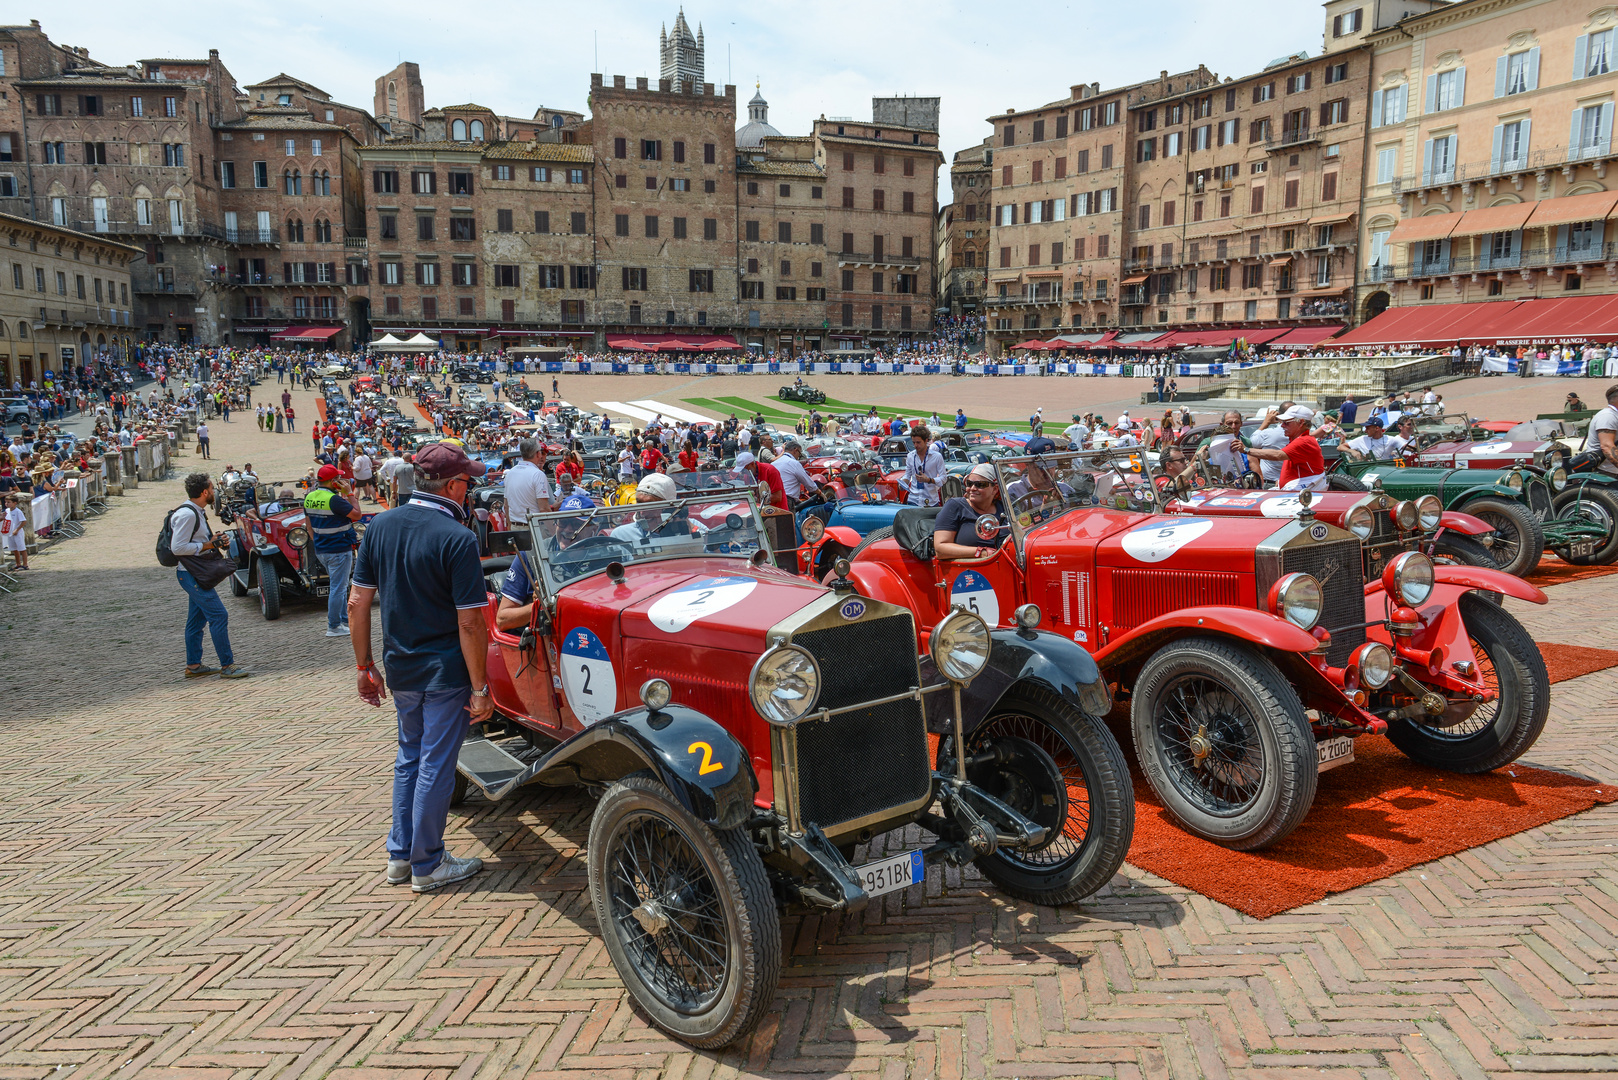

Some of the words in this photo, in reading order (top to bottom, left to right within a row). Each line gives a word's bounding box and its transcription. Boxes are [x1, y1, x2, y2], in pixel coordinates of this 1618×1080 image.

[1129, 454, 1142, 472] 5
[302, 480, 308, 490] 3
[306, 499, 326, 508] STAFF
[1158, 528, 1176, 538] 5
[1314, 528, 1325, 536] OM
[1570, 544, 1586, 556] FYE
[1588, 542, 1593, 554] 7
[688, 590, 714, 606] 2
[969, 596, 980, 615] 5
[844, 604, 861, 616] OM
[580, 664, 593, 696] 2
[688, 742, 724, 776] 2
[866, 860, 911, 892] 931BK
